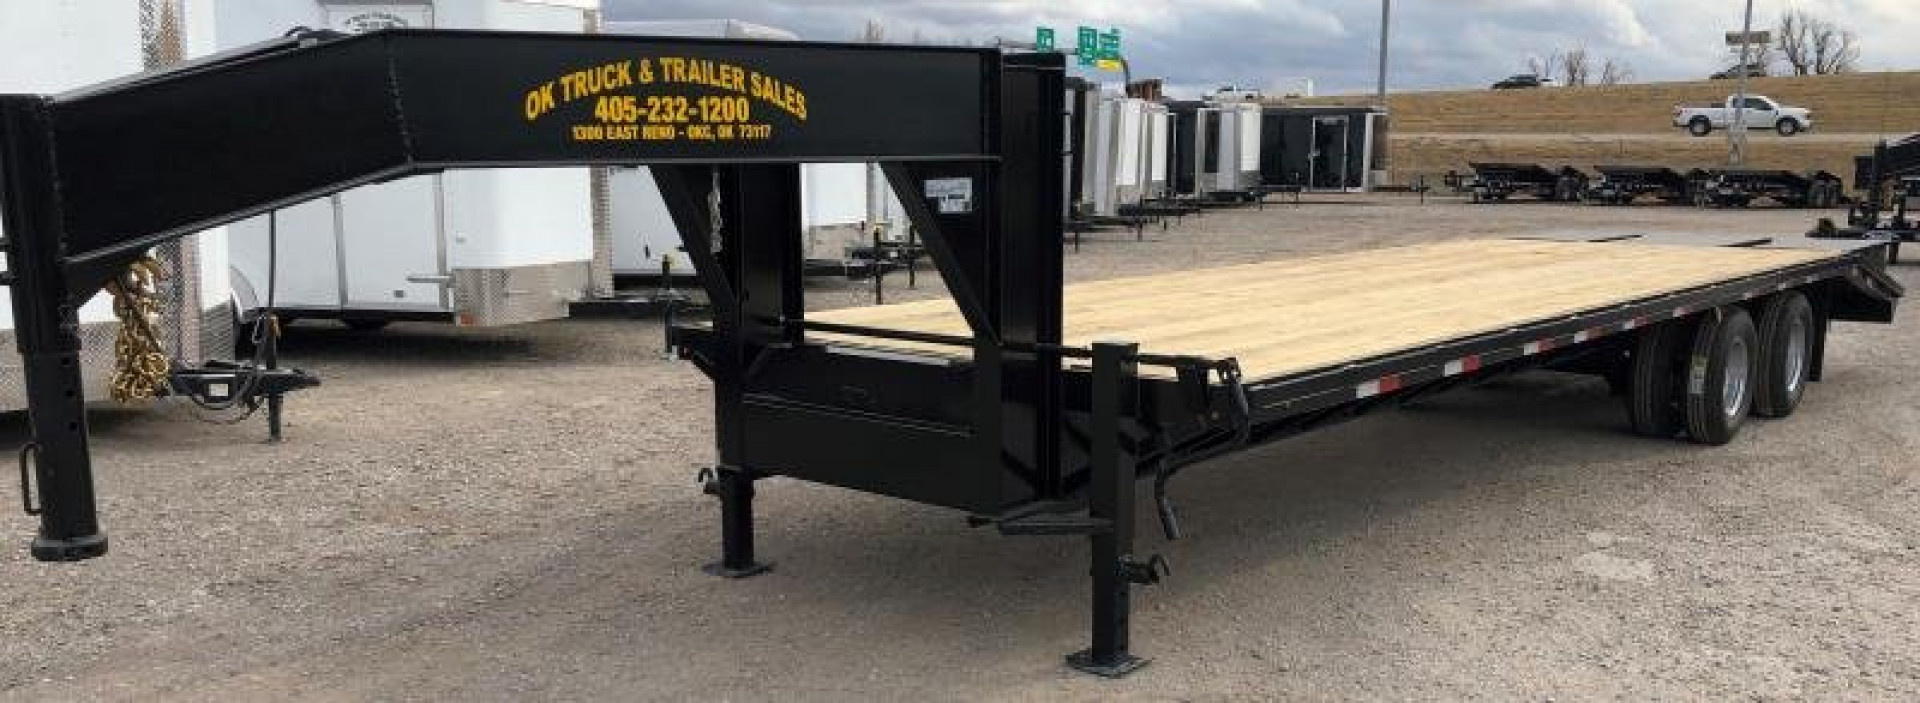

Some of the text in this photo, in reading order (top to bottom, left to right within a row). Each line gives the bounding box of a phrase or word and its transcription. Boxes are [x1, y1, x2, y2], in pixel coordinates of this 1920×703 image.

[526, 57, 807, 120] OK TRUCK & TRAILER SALES
[595, 96, 749, 122] 405-232-1200
[606, 125, 639, 139] EAST
